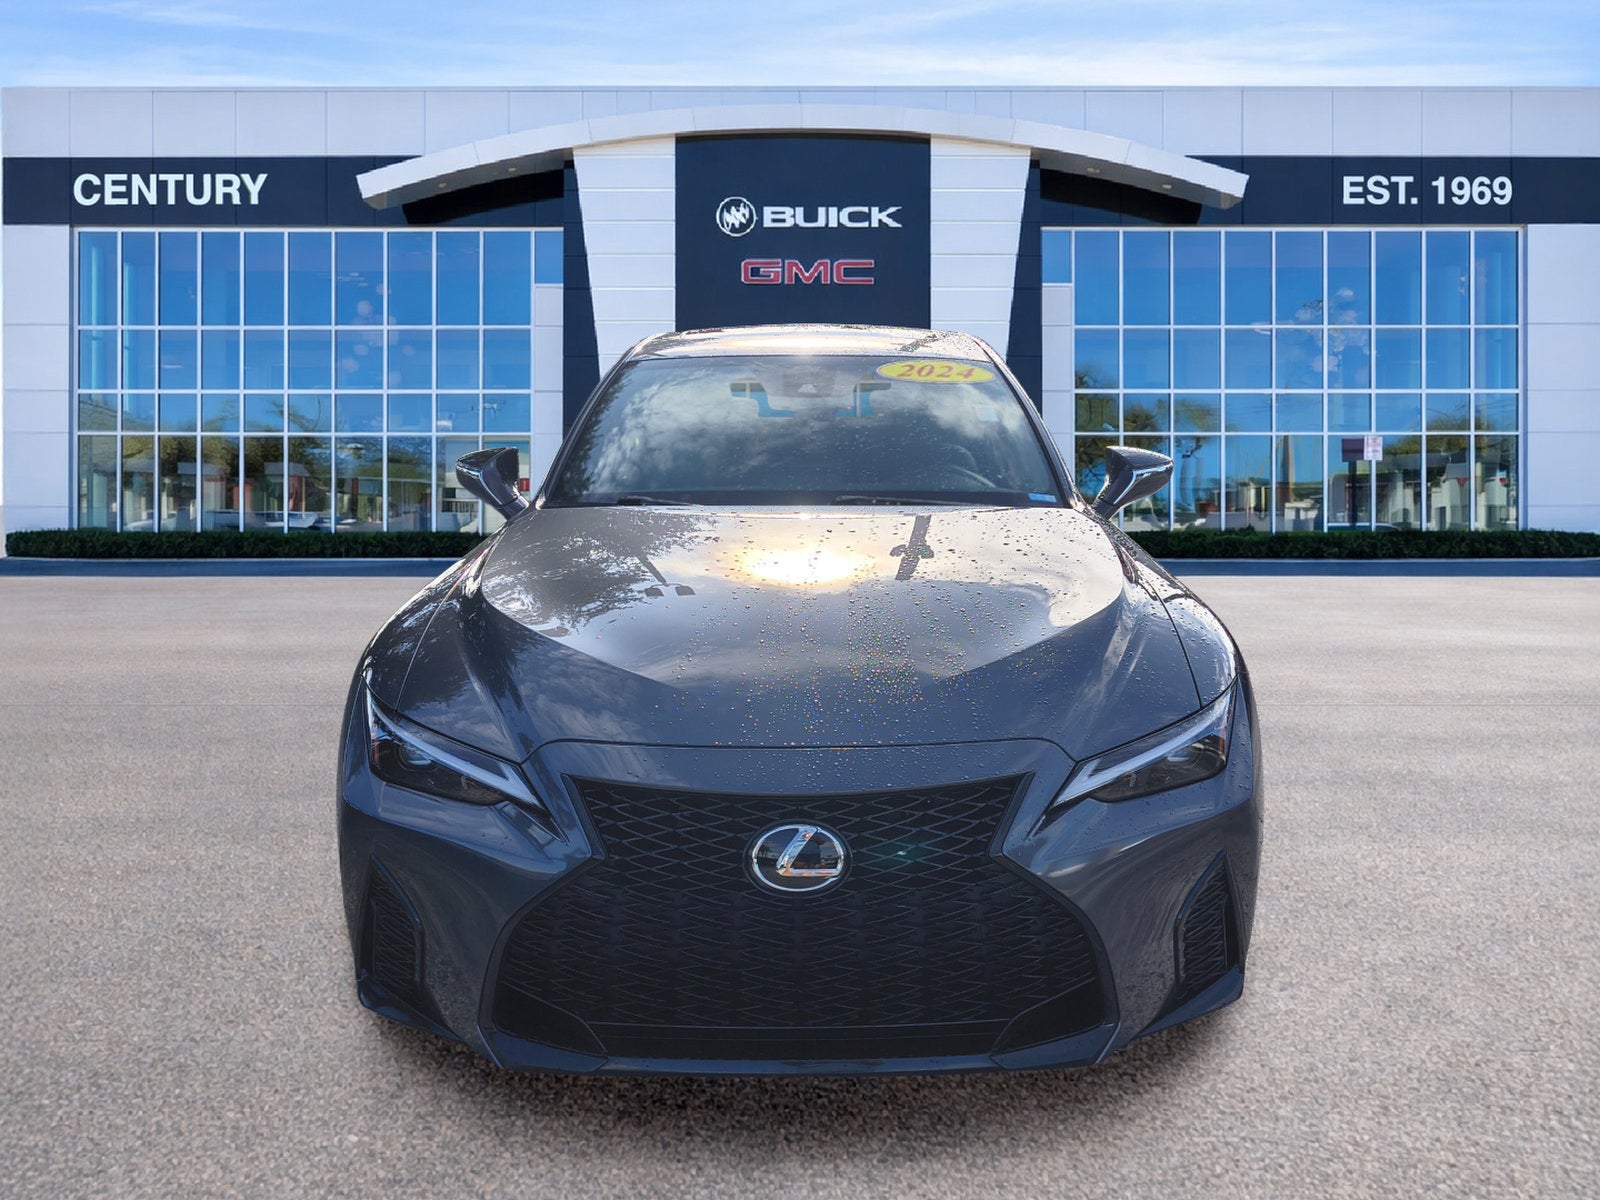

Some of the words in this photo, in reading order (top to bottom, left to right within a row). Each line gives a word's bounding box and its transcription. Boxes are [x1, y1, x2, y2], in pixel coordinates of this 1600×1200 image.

[73, 173, 268, 206] CENTURY
[1343, 175, 1418, 205] EST.
[1431, 176, 1513, 205] 1969
[763, 206, 903, 228] BUICK
[741, 258, 875, 285] GMC
[896, 363, 977, 379] 2024
